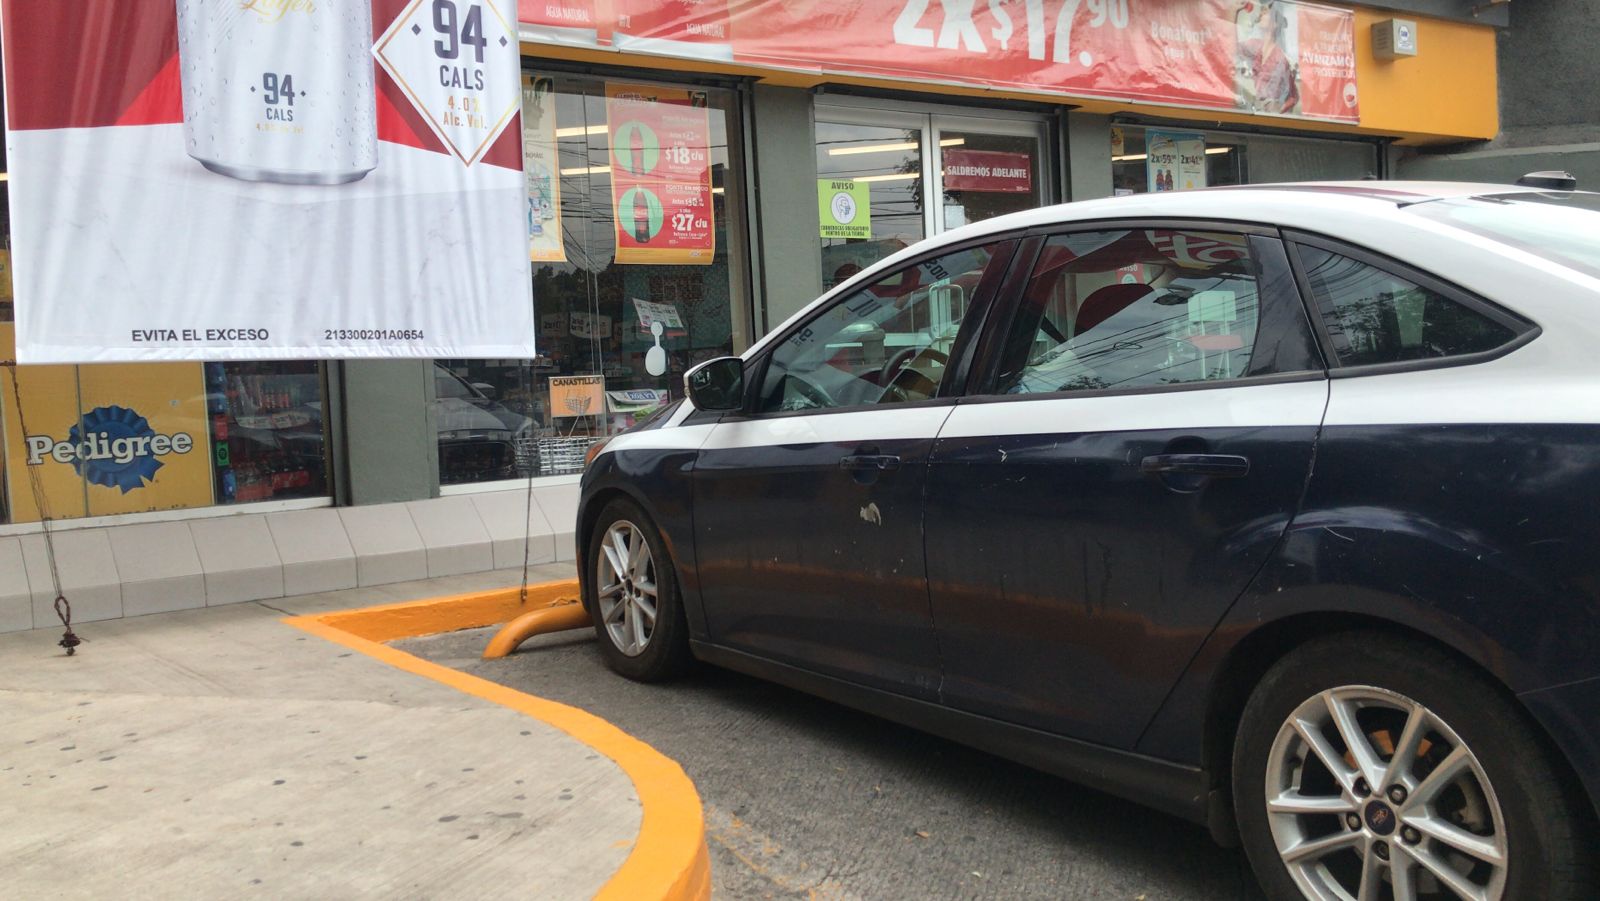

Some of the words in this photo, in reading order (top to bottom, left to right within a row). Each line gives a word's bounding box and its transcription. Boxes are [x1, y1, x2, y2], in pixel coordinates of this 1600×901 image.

[546, 5, 562, 18] AGUA
[563, 8, 590, 22] NATURAL
[432, 0, 487, 63] 94
[440, 65, 484, 91] CALS
[262, 72, 296, 106] 94
[265, 107, 294, 122] CALS
[443, 111, 464, 127] Alc.
[665, 145, 690, 164] $18
[947, 165, 990, 177] SALDREMOS
[991, 167, 1027, 179] ADELANTE
[831, 182, 855, 190] AVISO
[671, 213, 694, 231] $27
[695, 218, 708, 228] c/u
[131, 329, 178, 342] EVITA
[182, 329, 203, 341] EL
[206, 328, 269, 341] EXCESO
[324, 329, 424, 341] 213300201A0654
[552, 378, 601, 387] CANASTILLAS
[26, 431, 193, 466] Pedigree
